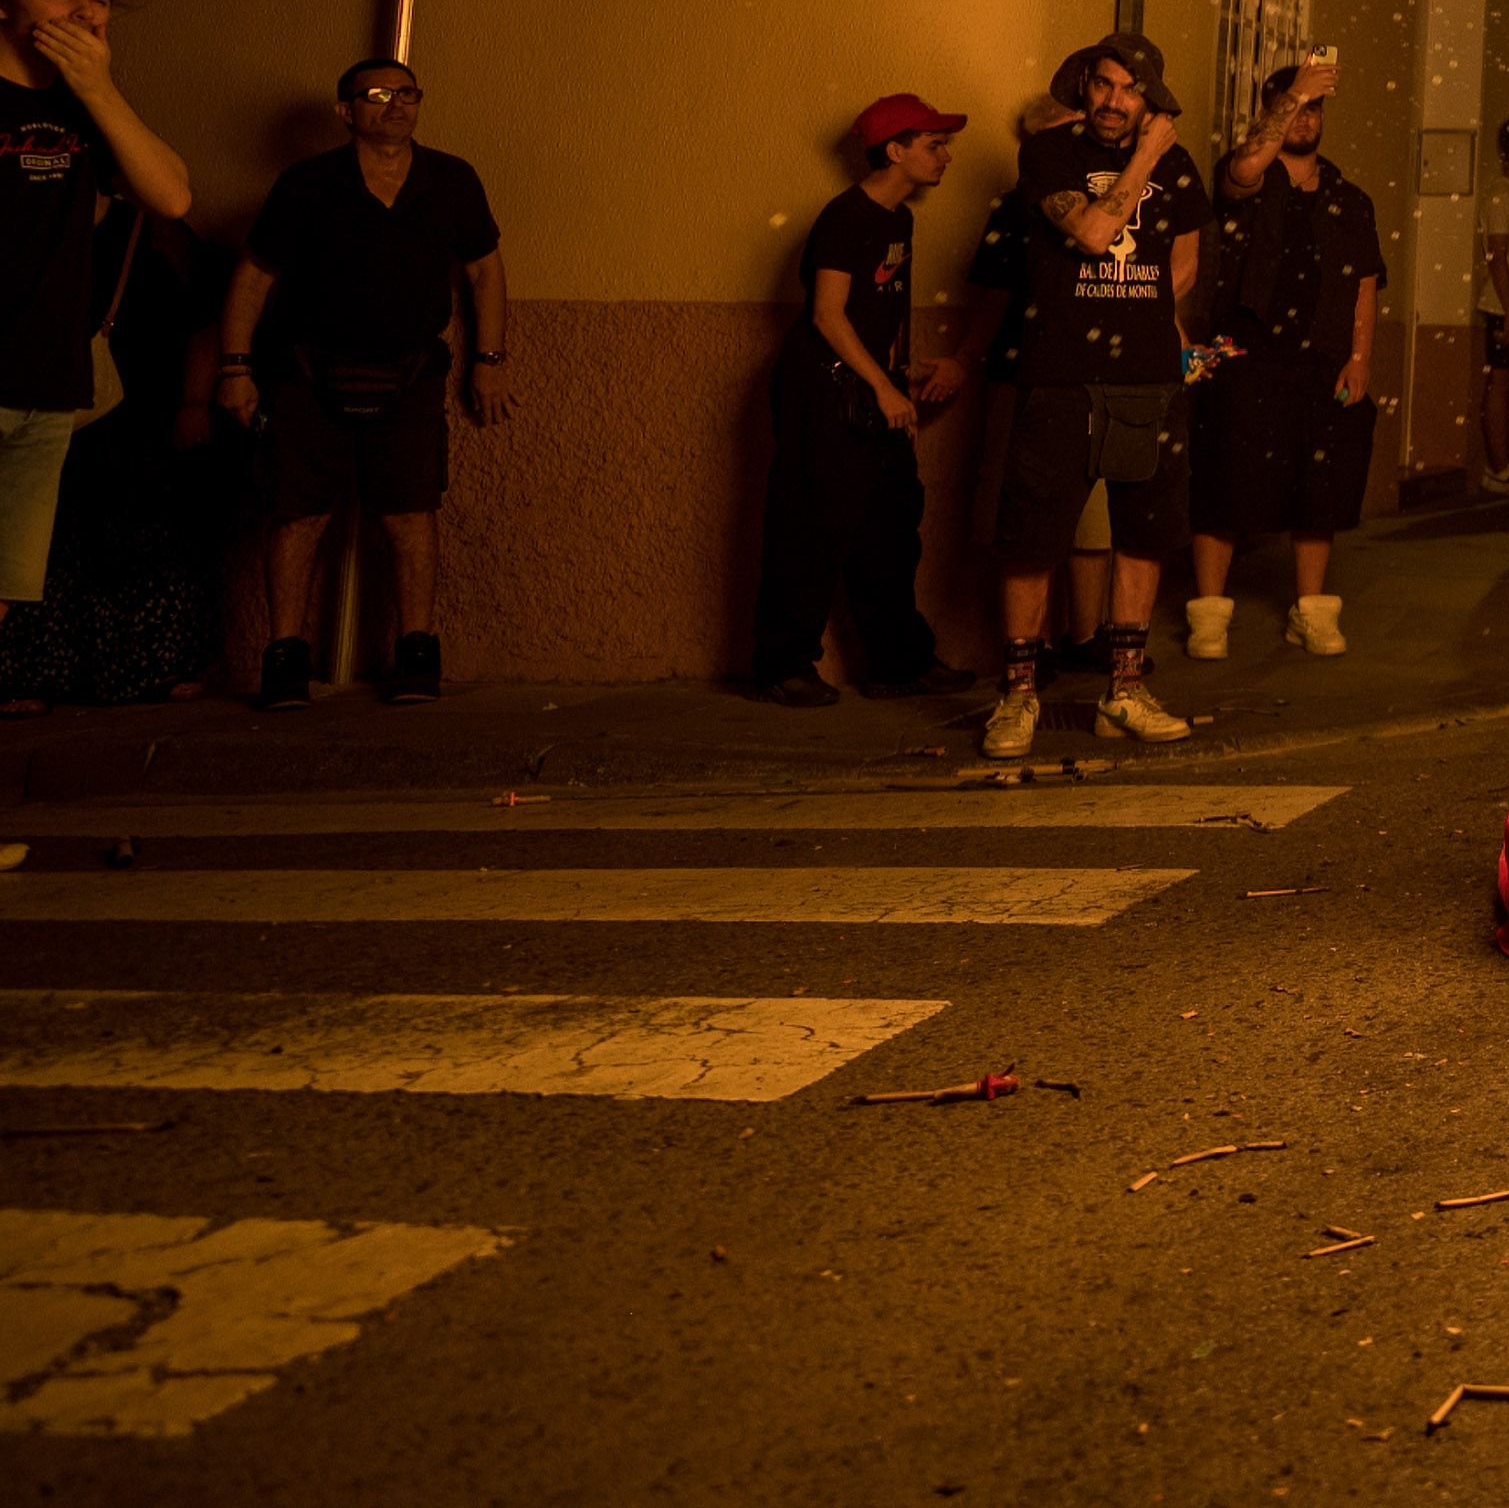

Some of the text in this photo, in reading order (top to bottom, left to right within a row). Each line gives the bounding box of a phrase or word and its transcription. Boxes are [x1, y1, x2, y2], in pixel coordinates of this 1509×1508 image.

[1099, 262, 1114, 280] DE
[1126, 263, 1160, 281] DIABLES
[876, 280, 903, 293] AIR
[1116, 284, 1127, 299] DE
